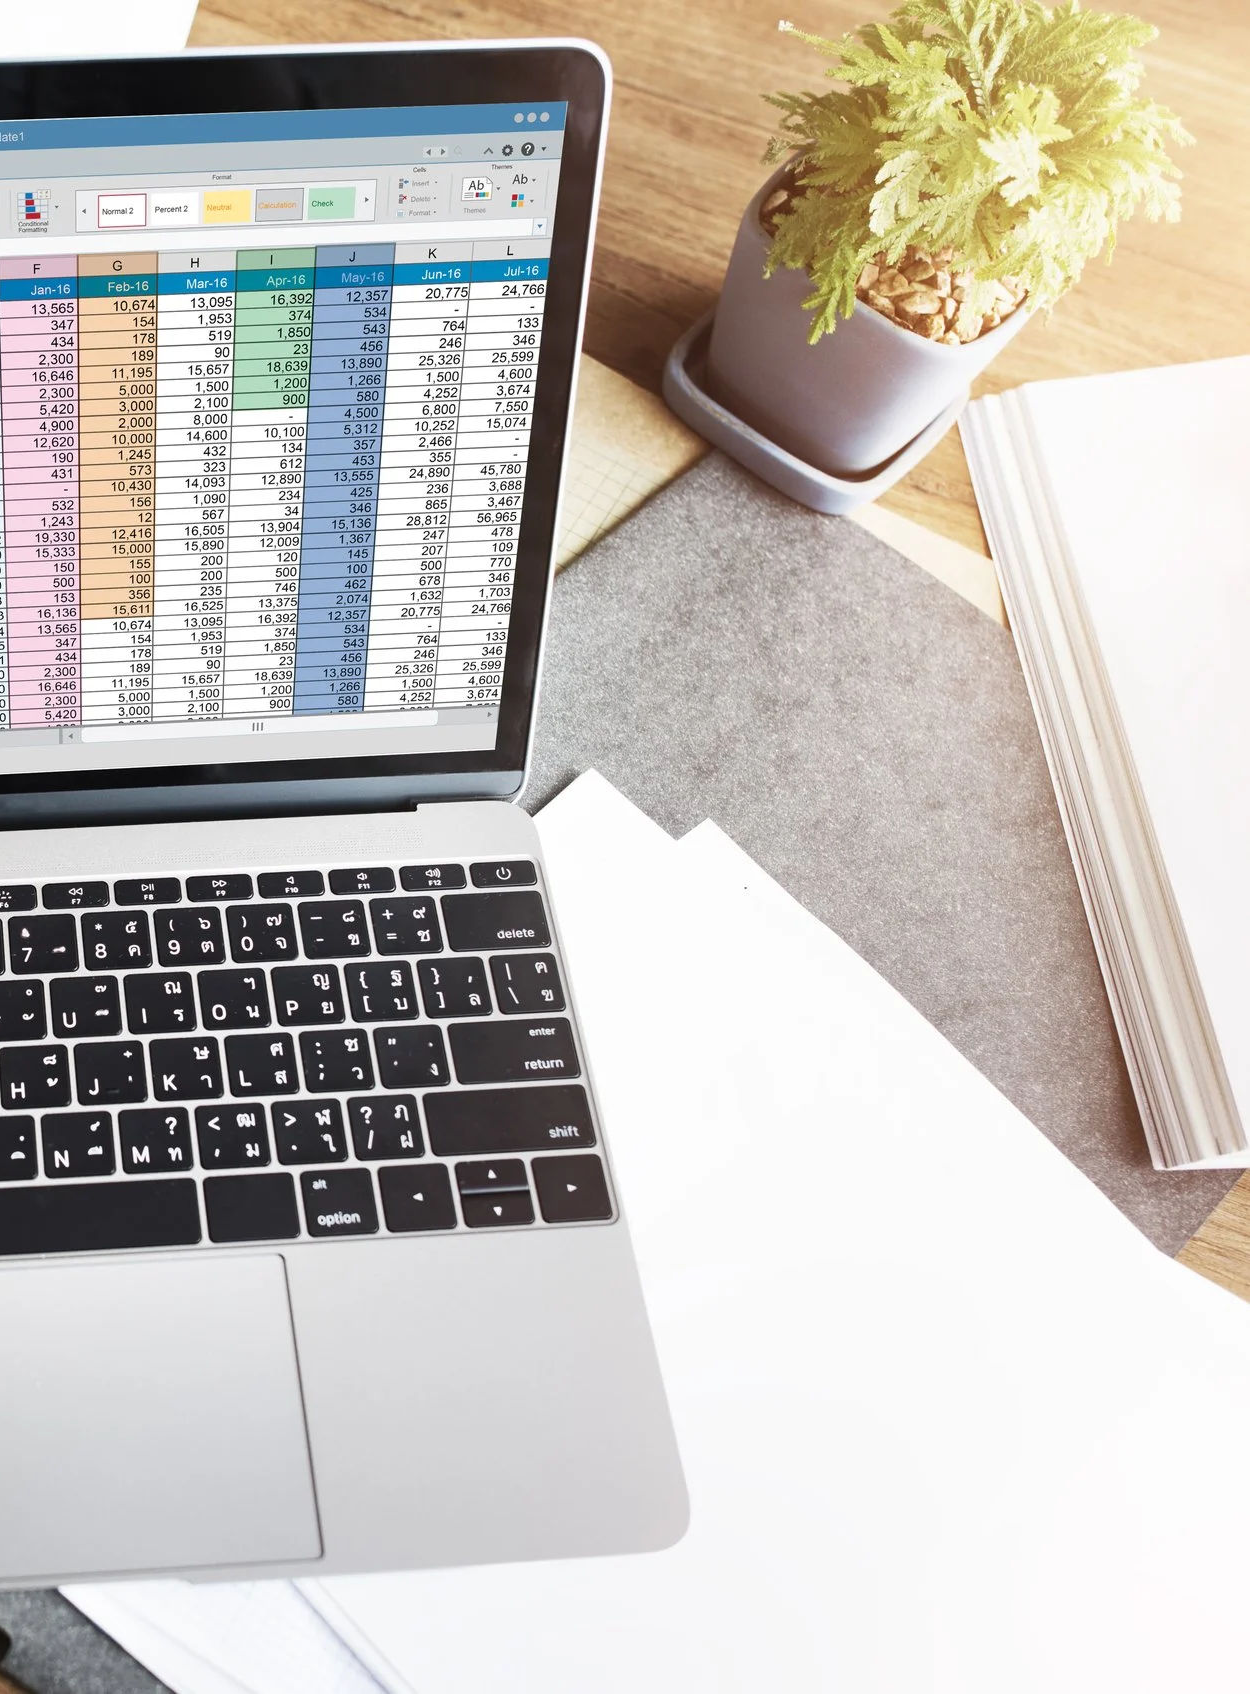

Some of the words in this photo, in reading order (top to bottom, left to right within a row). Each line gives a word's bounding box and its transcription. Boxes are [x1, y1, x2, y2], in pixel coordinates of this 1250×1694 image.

[468, 180, 485, 191] Ab
[512, 174, 528, 185] Ab
[154, 205, 181, 214] Percent
[207, 203, 232, 212] Neutral
[258, 201, 296, 209] Calculation
[311, 200, 334, 208] Check
[102, 207, 126, 216] Normal
[429, 249, 437, 258] K
[507, 246, 513, 256] L
[112, 261, 123, 271] G
[504, 265, 539, 277] Jul-16
[341, 271, 385, 285] May-16
[421, 268, 461, 280] Jun-16
[30, 282, 70, 295] Jan-16
[107, 280, 150, 293] Feb-16
[186, 277, 228, 290] Mar-16
[266, 274, 306, 289] Apr-16
[346, 289, 389, 304] 12,357
[425, 286, 469, 300] 20,775
[502, 282, 545, 297] 24,766
[113, 298, 155, 314] 10,674
[191, 294, 233, 309] 13,095
[270, 292, 314, 307] 16,392
[31, 301, 75, 316] 13,565
[492, 350, 535, 365] 25,599
[267, 360, 309, 374] 18,639
[424, 387, 458, 401] 4,252
[486, 416, 527, 430] 15,074
[481, 463, 522, 478] 45,780
[477, 511, 517, 525] 56,965
[34, 531, 76, 544] 19,330
[38, 606, 77, 620] 16,136
[400, 605, 441, 619] 20,775
[497, 928, 535, 940] delete
[287, 1001, 298, 1016] P
[528, 1026, 555, 1036] enter
[524, 1057, 564, 1070] return
[164, 1075, 177, 1091] K
[549, 1124, 580, 1139] shift
[132, 1146, 150, 1163] M
[312, 1178, 327, 1189] alt
[318, 1210, 361, 1227] option
